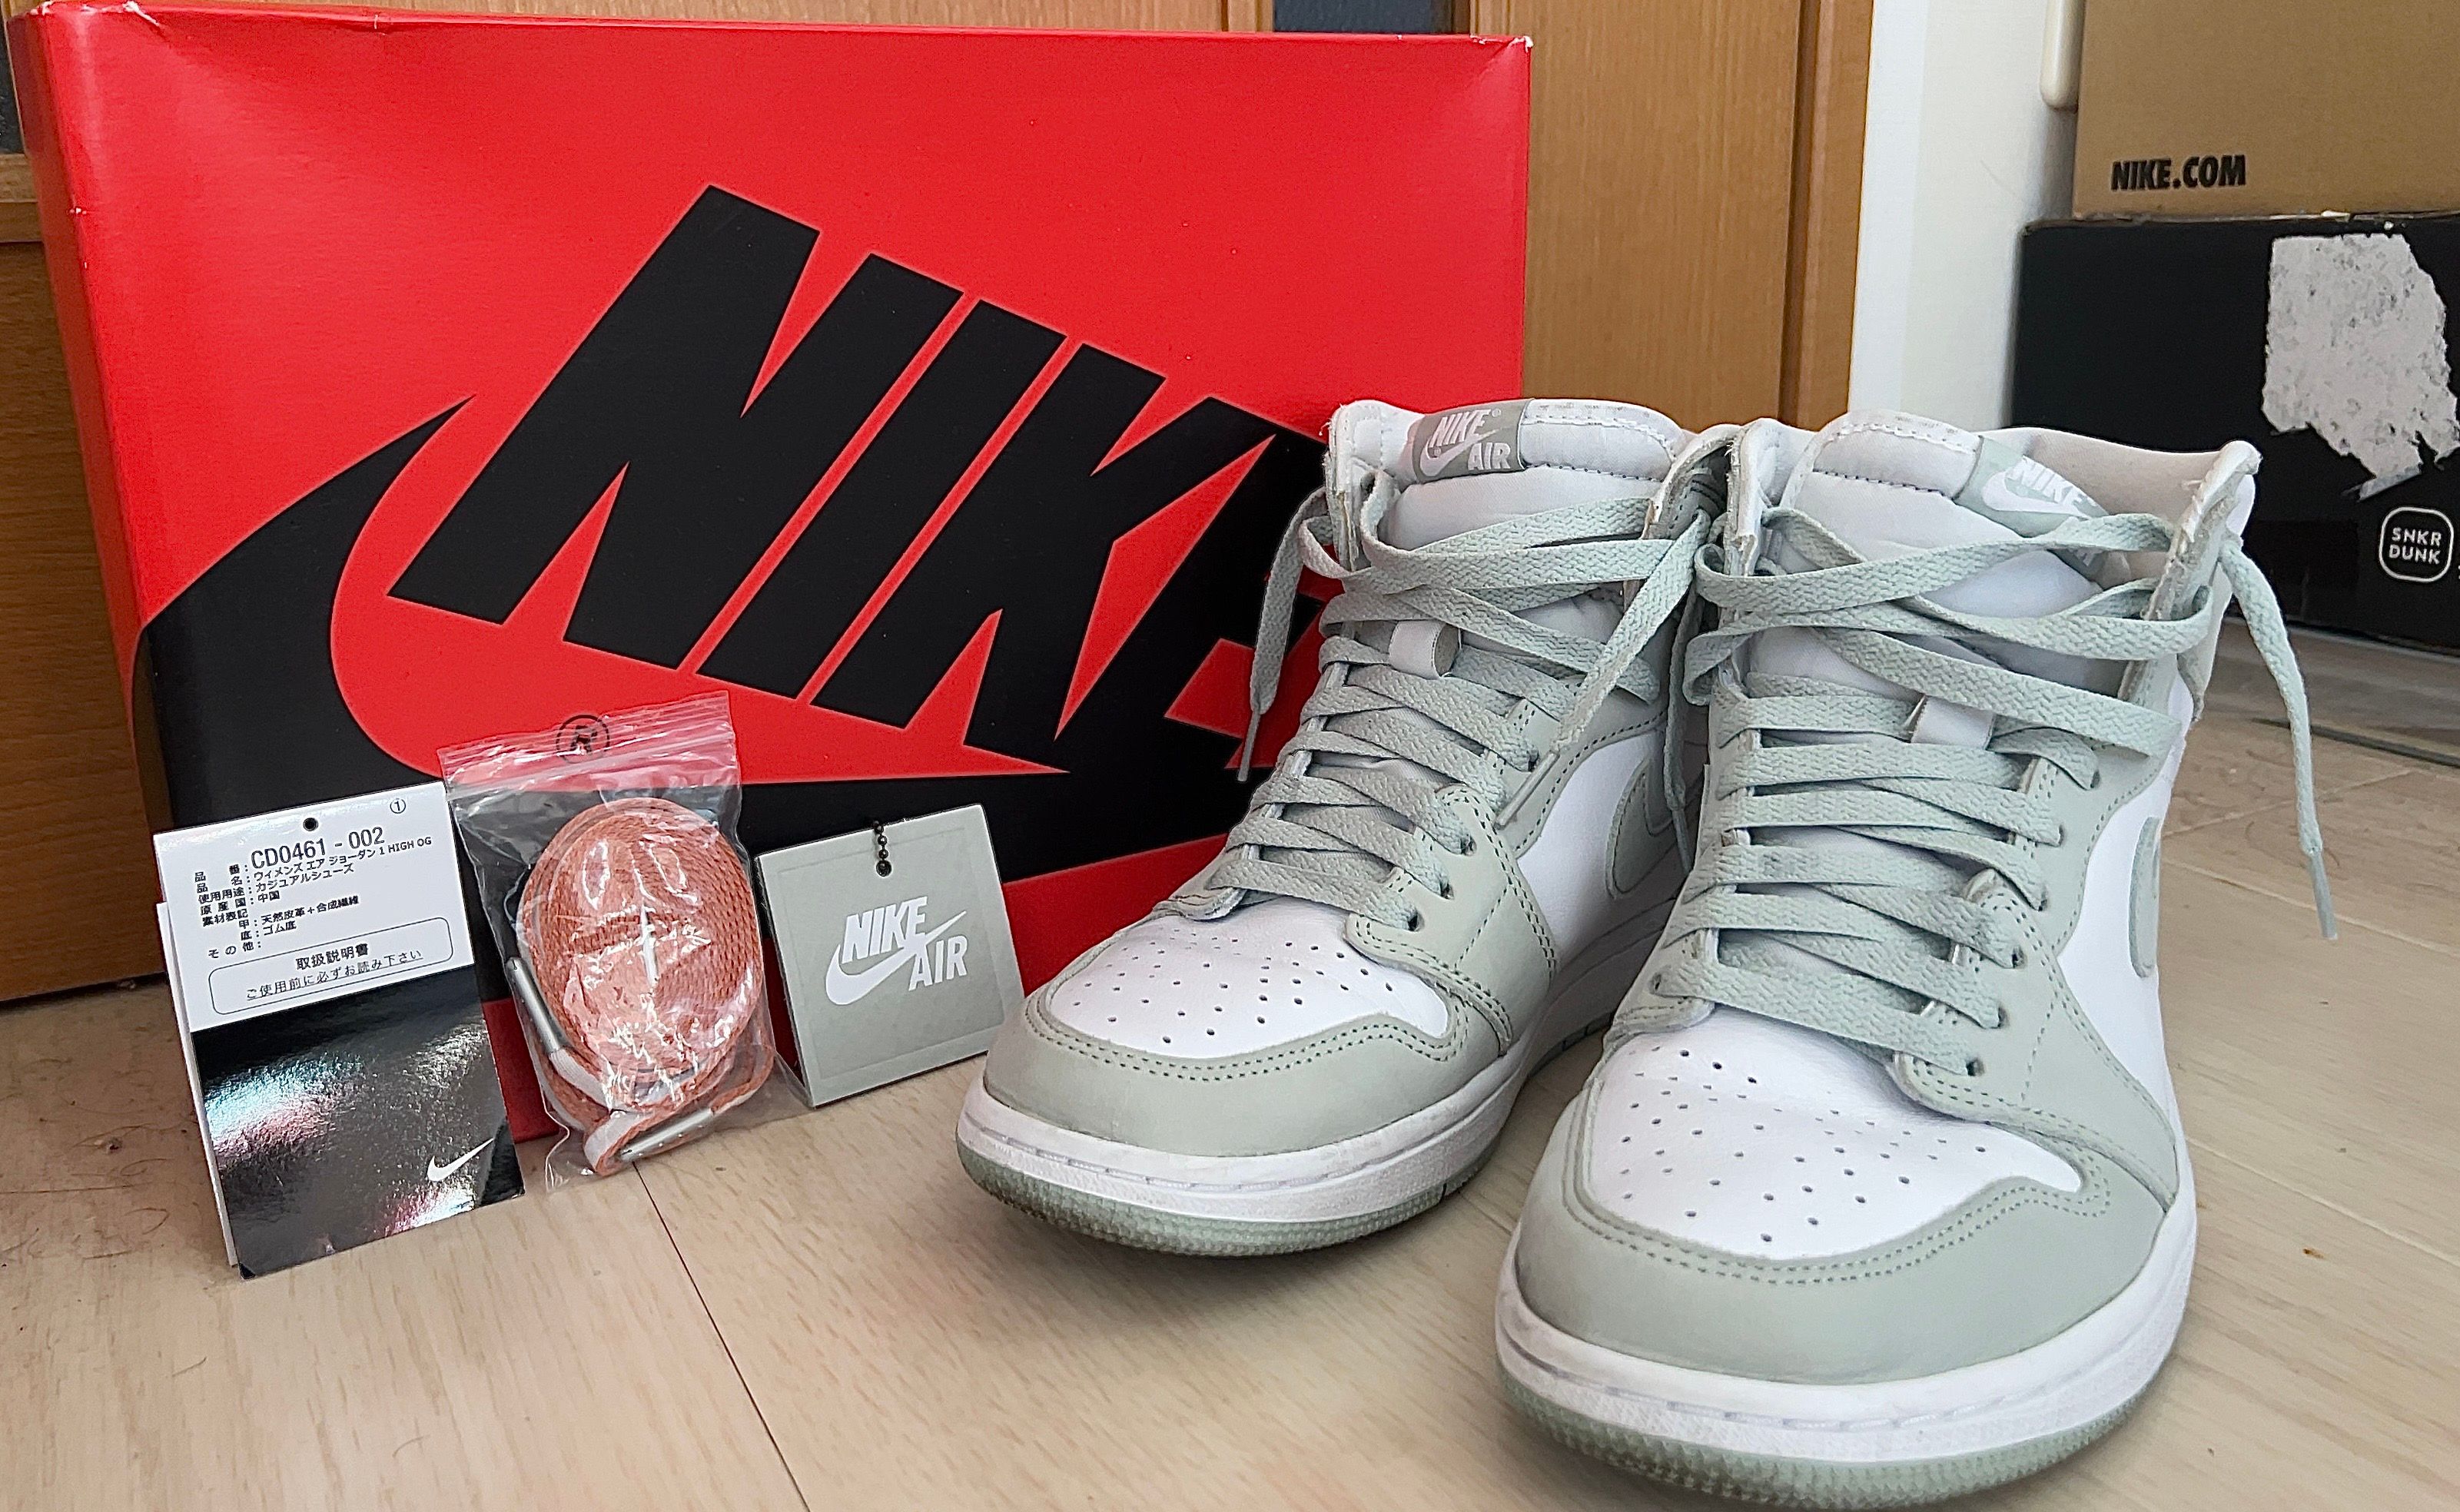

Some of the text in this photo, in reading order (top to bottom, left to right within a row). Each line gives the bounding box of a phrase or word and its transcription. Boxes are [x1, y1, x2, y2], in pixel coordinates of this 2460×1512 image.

[2111, 154, 2246, 191] NIKE.COM
[1429, 409, 1492, 448] NIKE
[1468, 442, 1511, 470] AIR
[2392, 527, 2442, 547] SNKR
[2389, 544, 2441, 565] DUNK
[388, 842, 415, 854] HIGH
[417, 837, 433, 847] OG
[842, 896, 928, 964] NIKE
[296, 943, 368, 970] 取扱説明書
[908, 935, 968, 992] AIR
[246, 949, 422, 999] ご使用前に必ずお読み下さい
